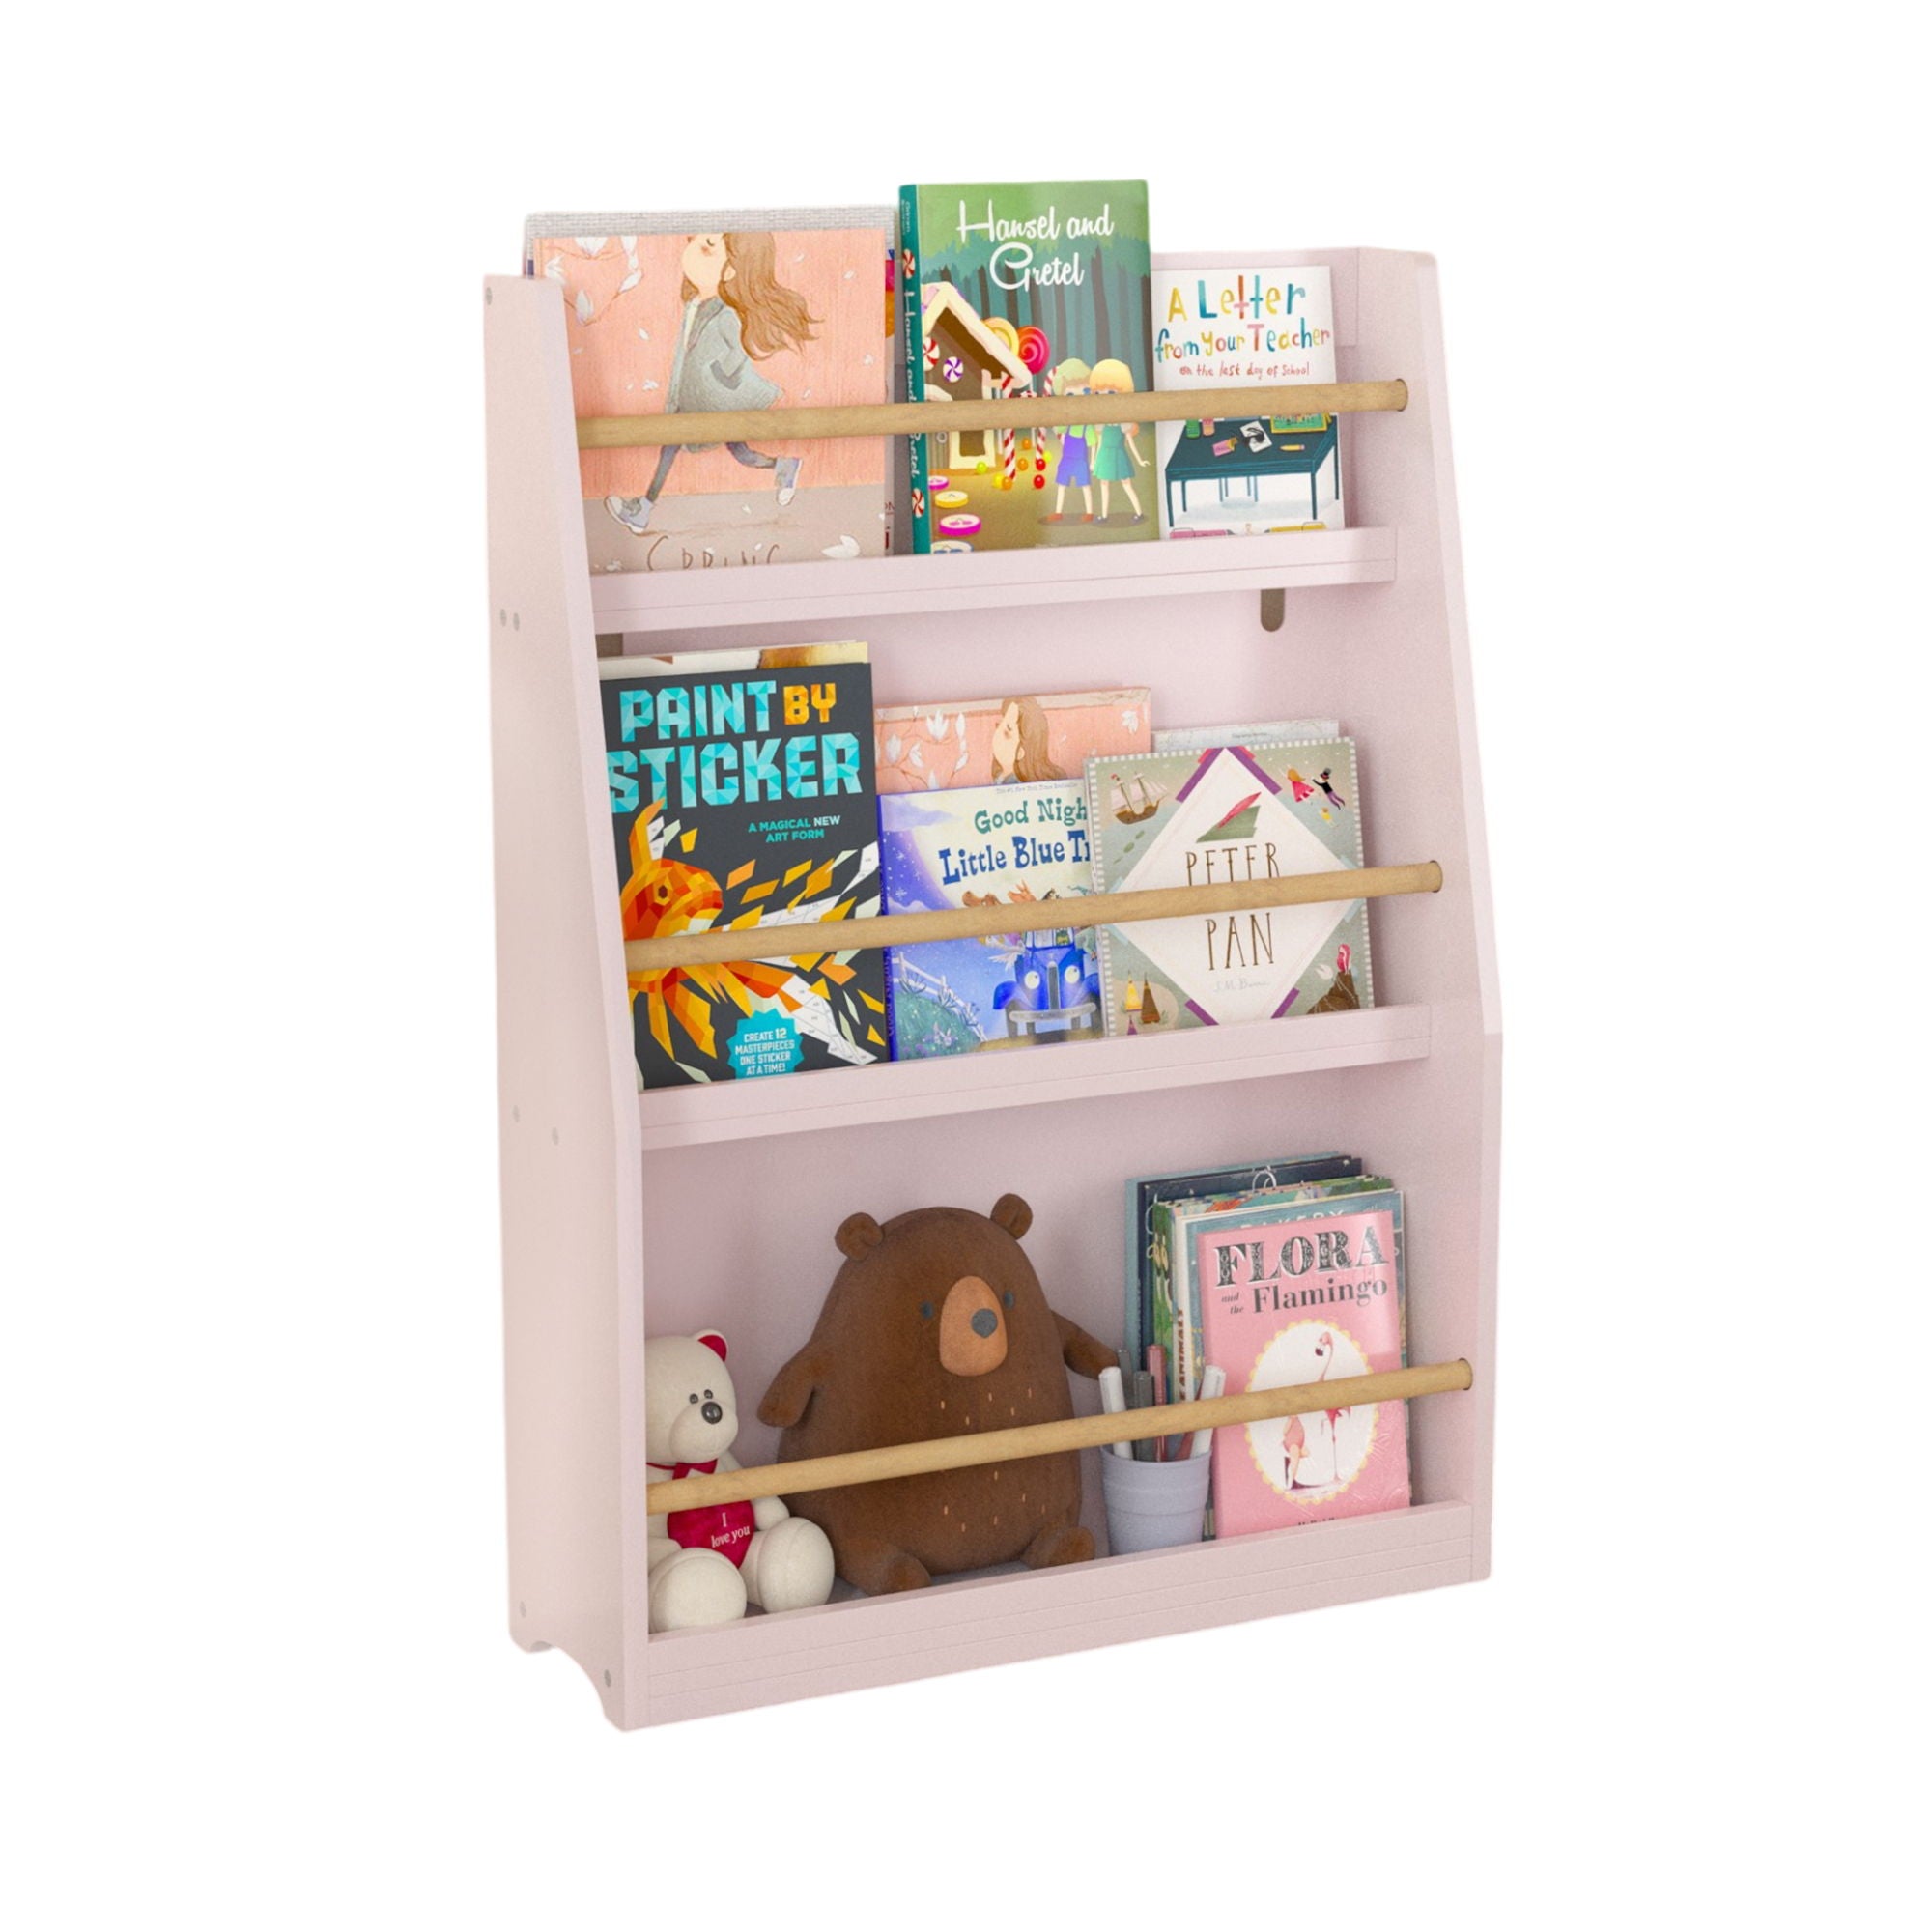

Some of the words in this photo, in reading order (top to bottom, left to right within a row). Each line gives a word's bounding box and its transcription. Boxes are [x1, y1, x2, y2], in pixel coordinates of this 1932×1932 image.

[955, 199, 1061, 244] Hansel
[1065, 203, 1115, 240] and
[988, 242, 1086, 293] Gretel
[1168, 287, 1188, 322] A
[1197, 274, 1306, 320] Letter
[903, 291, 916, 364] Hansel
[1154, 328, 1200, 364] from
[1200, 330, 1245, 356] your
[1246, 317, 1331, 352] Teacher
[1179, 365, 1193, 376] on
[1196, 363, 1214, 377] the
[1246, 361, 1264, 381] day
[1266, 364, 1279, 378] of
[1282, 361, 1310, 377] School
[619, 680, 777, 743] PAINT
[783, 682, 837, 725] BY
[606, 731, 864, 814] STICKER
[748, 822, 758, 833] A
[758, 817, 811, 832] MAGICAL
[813, 814, 841, 827] NEW
[974, 799, 1030, 835] Good
[1037, 796, 1089, 827] Nigh
[765, 831, 789, 843] ART
[791, 828, 825, 840] FORM
[938, 843, 1008, 886] Little
[1011, 835, 1065, 869] Blue
[1205, 912, 1274, 971] PAN
[735, 1039, 795, 1055] MASTERPIECES
[743, 1031, 774, 1043] CREATE
[775, 1027, 787, 1039] 12
[740, 1055, 756, 1065] ONE
[757, 1051, 791, 1064] STICKER
[746, 1065, 756, 1076] AT
[756, 1065, 764, 1074] A
[1213, 1225, 1389, 1289] FLORA
[1220, 1292, 1240, 1303] and
[1229, 1305, 1245, 1315] the
[1253, 1277, 1388, 1315] Flamingo
[711, 1534, 730, 1548] love
[731, 1525, 751, 1545] you
[722, 1512, 727, 1527] I
